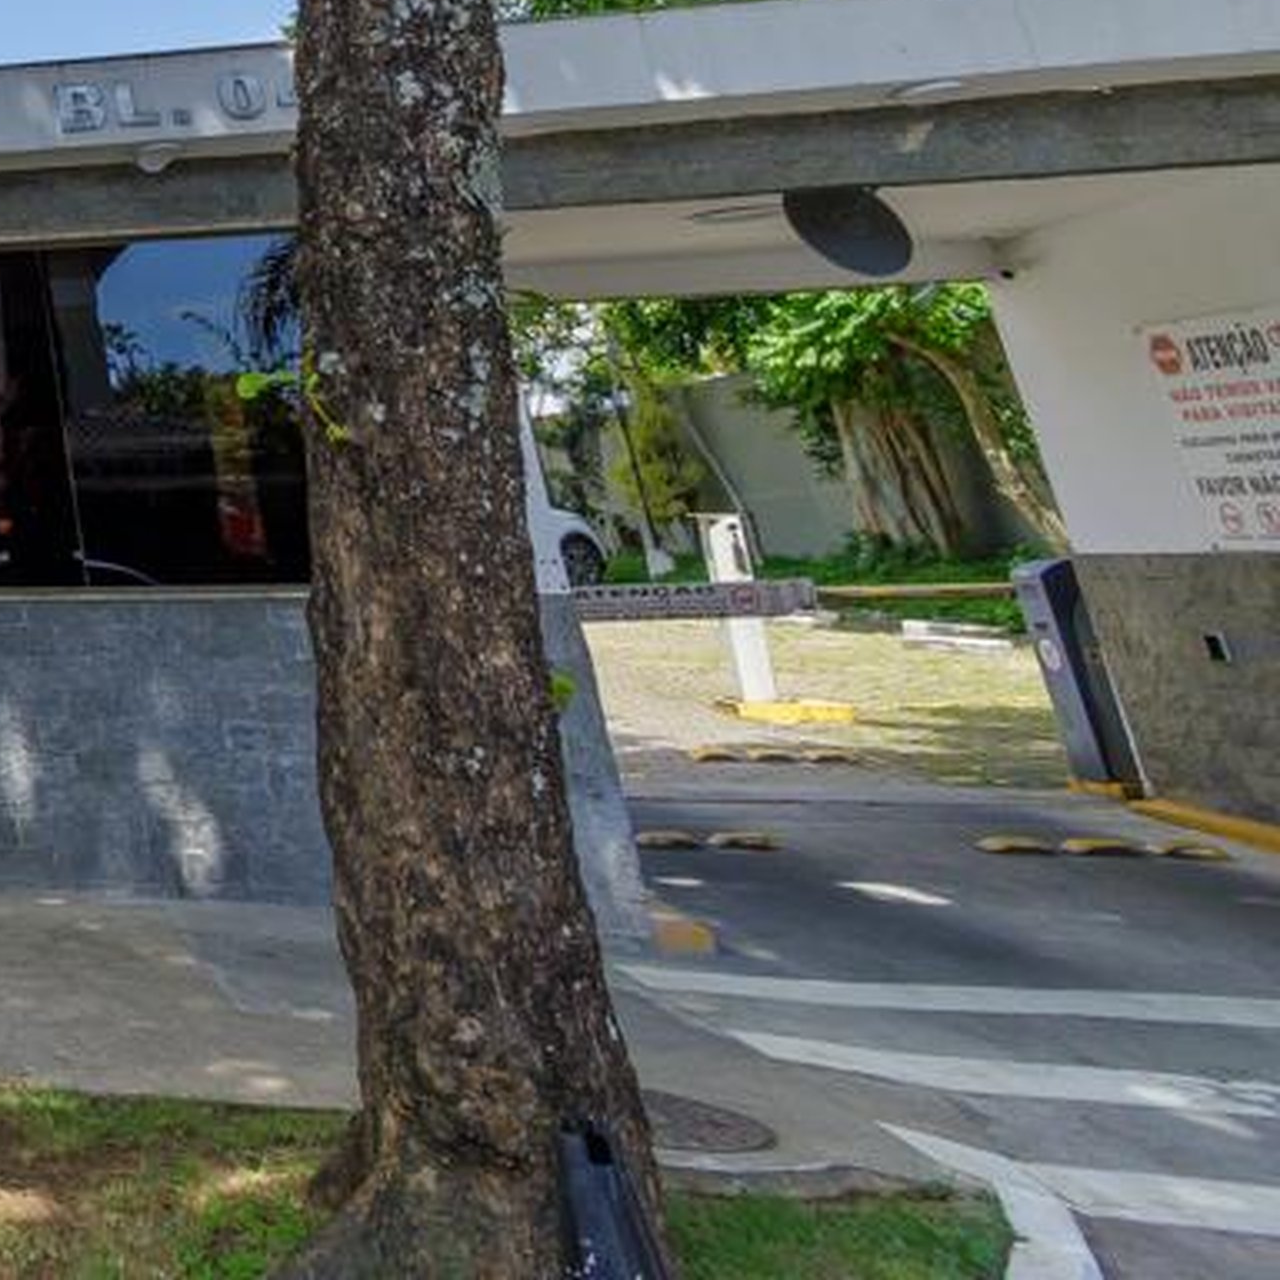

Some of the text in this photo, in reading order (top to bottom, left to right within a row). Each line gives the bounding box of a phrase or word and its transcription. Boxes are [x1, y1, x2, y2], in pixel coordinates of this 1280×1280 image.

[52, 79, 193, 134] BL.
[1185, 321, 1271, 376] ATENÇÃO
[1195, 474, 1249, 497] FAVOR
